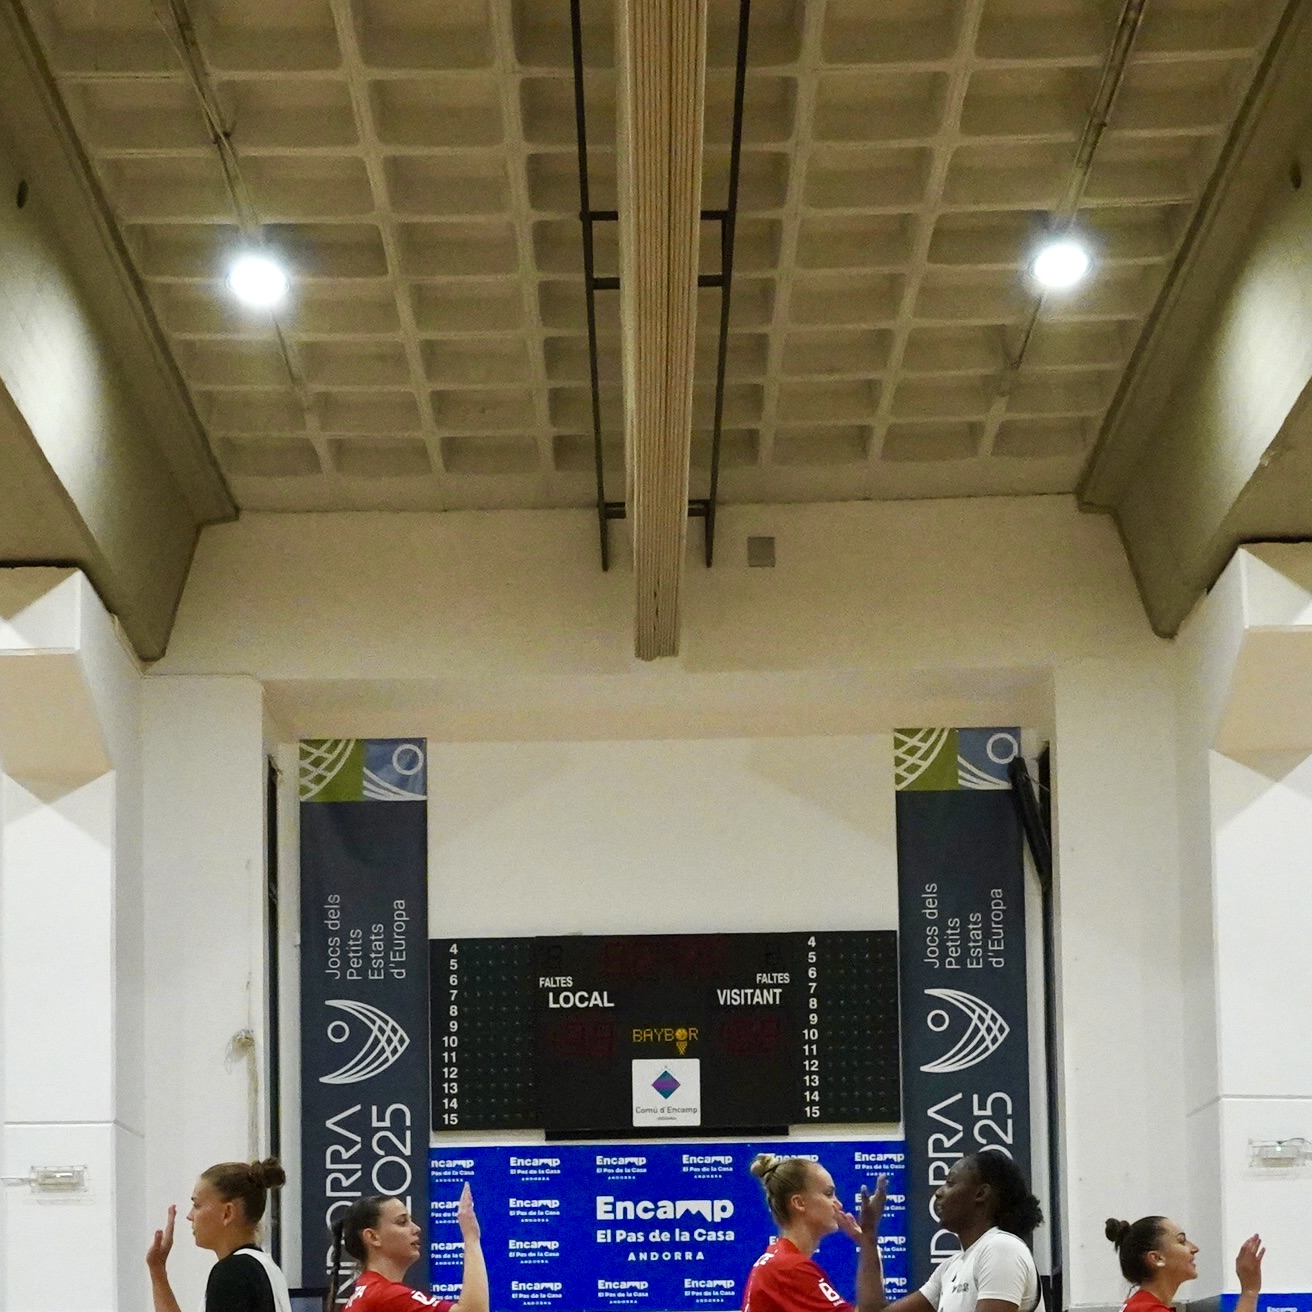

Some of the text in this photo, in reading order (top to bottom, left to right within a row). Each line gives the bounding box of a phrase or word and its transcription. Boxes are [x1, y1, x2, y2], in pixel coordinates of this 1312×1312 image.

[922, 882, 939, 968] Jocs dels
[988, 887, 1007, 968] d'Europa
[325, 894, 340, 979] Jocs dels
[390, 899, 409, 979] d'Europa
[808, 937, 816, 947] 4
[967, 912, 983, 969] Estats
[945, 917, 960, 969] Petits
[347, 928, 363, 980] Petits
[368, 922, 384, 980] Estats
[450, 944, 457, 954] 4
[809, 952, 816, 962] 5
[450, 959, 457, 970] 5
[756, 972, 790, 984] FALTES
[809, 967, 816, 978] 6
[450, 975, 457, 985] 6
[539, 976, 573, 988] FALTES
[809, 983, 816, 993] 7
[450, 990, 457, 1000] 7
[548, 991, 615, 1008] LOCAL
[717, 988, 783, 1006] VISITANT
[809, 998, 817, 1008] 8
[450, 1005, 457, 1016] 8
[810, 1014, 817, 1024] 9
[450, 1021, 457, 1031] 9
[803, 1029, 818, 1039] 10
[443, 1036, 457, 1047] 10
[803, 1045, 816, 1055] 11
[443, 1052, 455, 1062] 11
[804, 1060, 818, 1070] 12
[443, 1067, 457, 1078] 12
[804, 1075, 819, 1086] 13
[443, 1083, 457, 1093] 13
[805, 1091, 819, 1101] 14
[443, 1098, 458, 1109] 14
[805, 1106, 819, 1117] 15
[443, 1114, 458, 1124] 15
[509, 1157, 561, 1168] Encamp
[595, 1156, 647, 1166] Encamp
[682, 1155, 733, 1165] Encamp
[854, 1152, 905, 1163] Encamp
[431, 1159, 474, 1168] ncamp
[509, 1198, 560, 1209] Encamp
[597, 1196, 735, 1223] Encamp
[597, 1229, 734, 1242] El Pas de la Casa
[508, 1240, 560, 1251] Encamp
[627, 1252, 704, 1261] ANDORRA
[511, 1281, 563, 1292] Encamp
[597, 1280, 649, 1290] Encamp
[684, 1279, 735, 1289] Encamp
